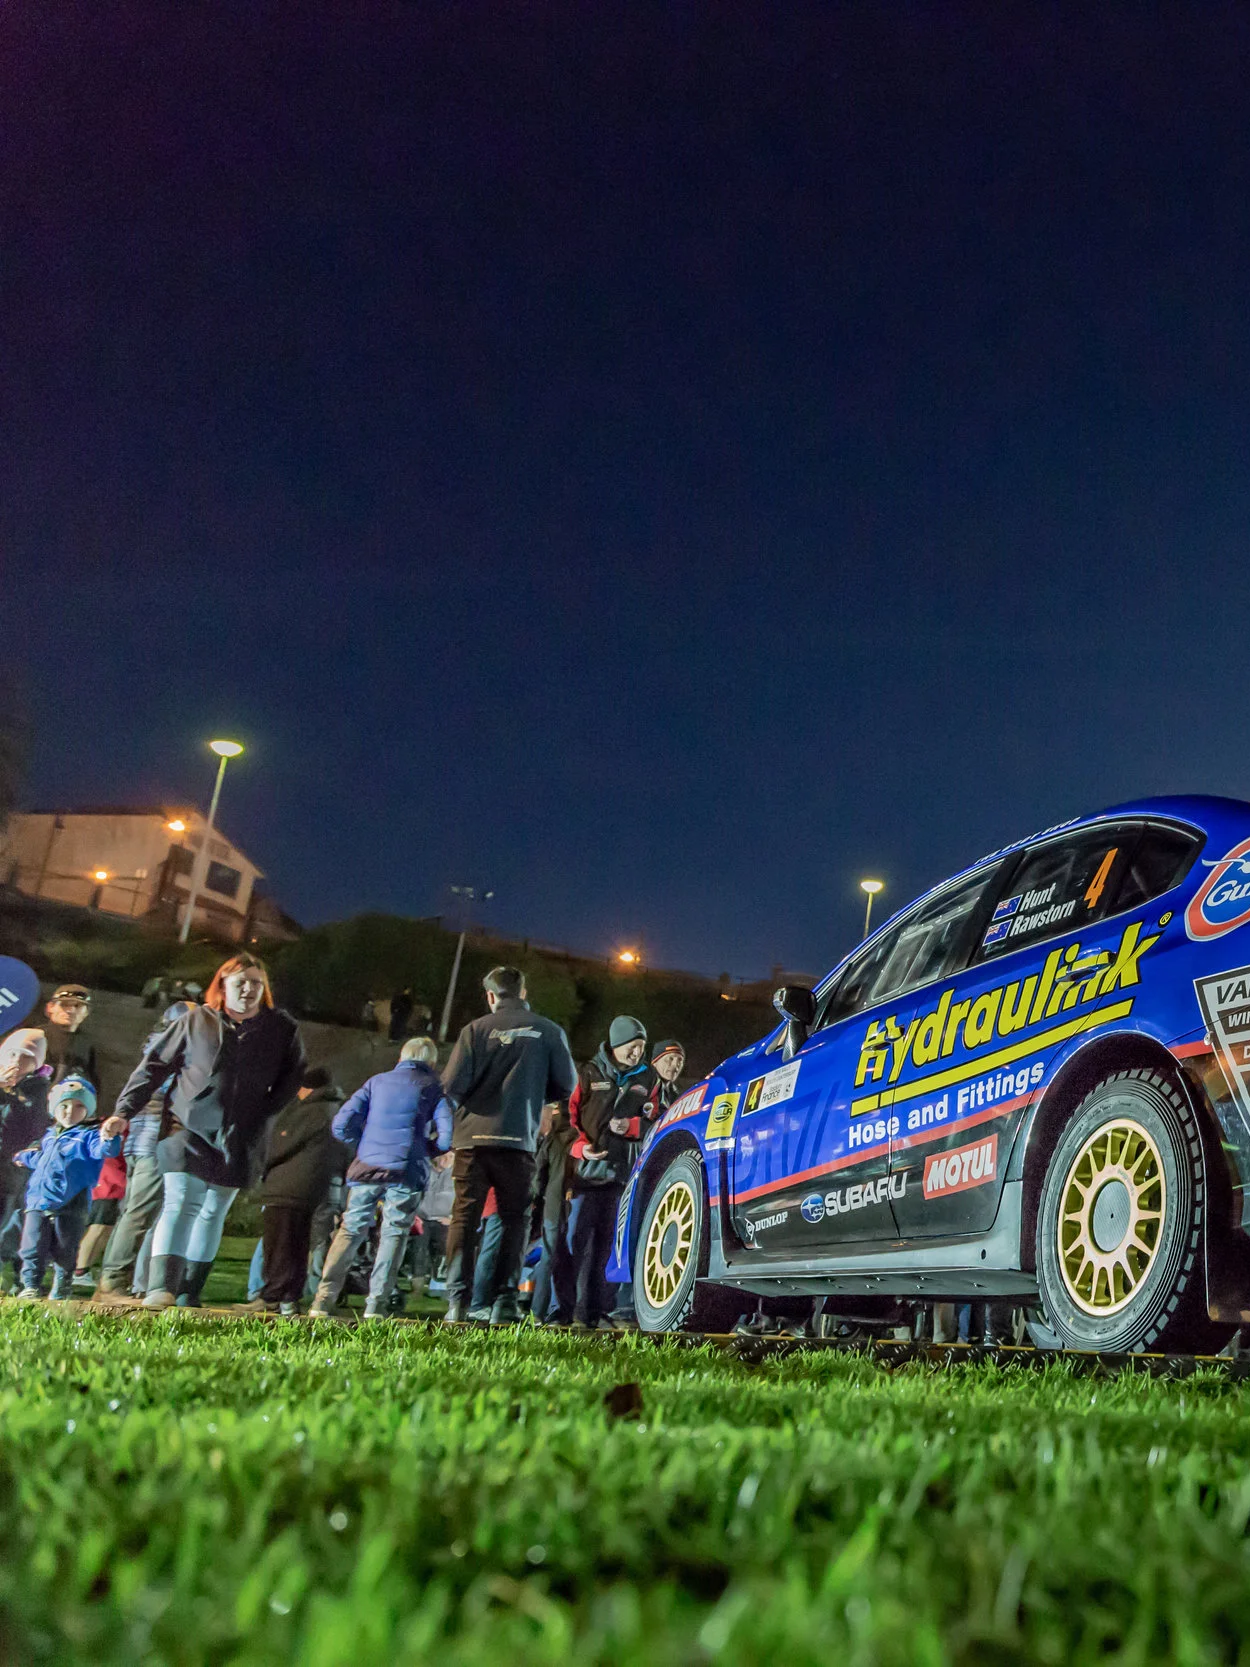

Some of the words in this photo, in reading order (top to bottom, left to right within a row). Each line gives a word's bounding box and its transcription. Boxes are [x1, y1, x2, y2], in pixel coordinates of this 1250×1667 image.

[1019, 882, 1056, 912] Hunt
[1084, 847, 1118, 909] 4
[1009, 899, 1076, 937] Rawstorn
[853, 921, 1161, 1086] Hydraulink
[660, 1089, 705, 1128] MOTUL
[748, 1081, 762, 1110] 4
[848, 1115, 900, 1149] Hose
[907, 1097, 949, 1129] and
[956, 1060, 1045, 1114] Fittings
[926, 1142, 994, 1193] MOTUL
[825, 1172, 907, 1217] SUBARU
[755, 1211, 788, 1231] DUNLOP
